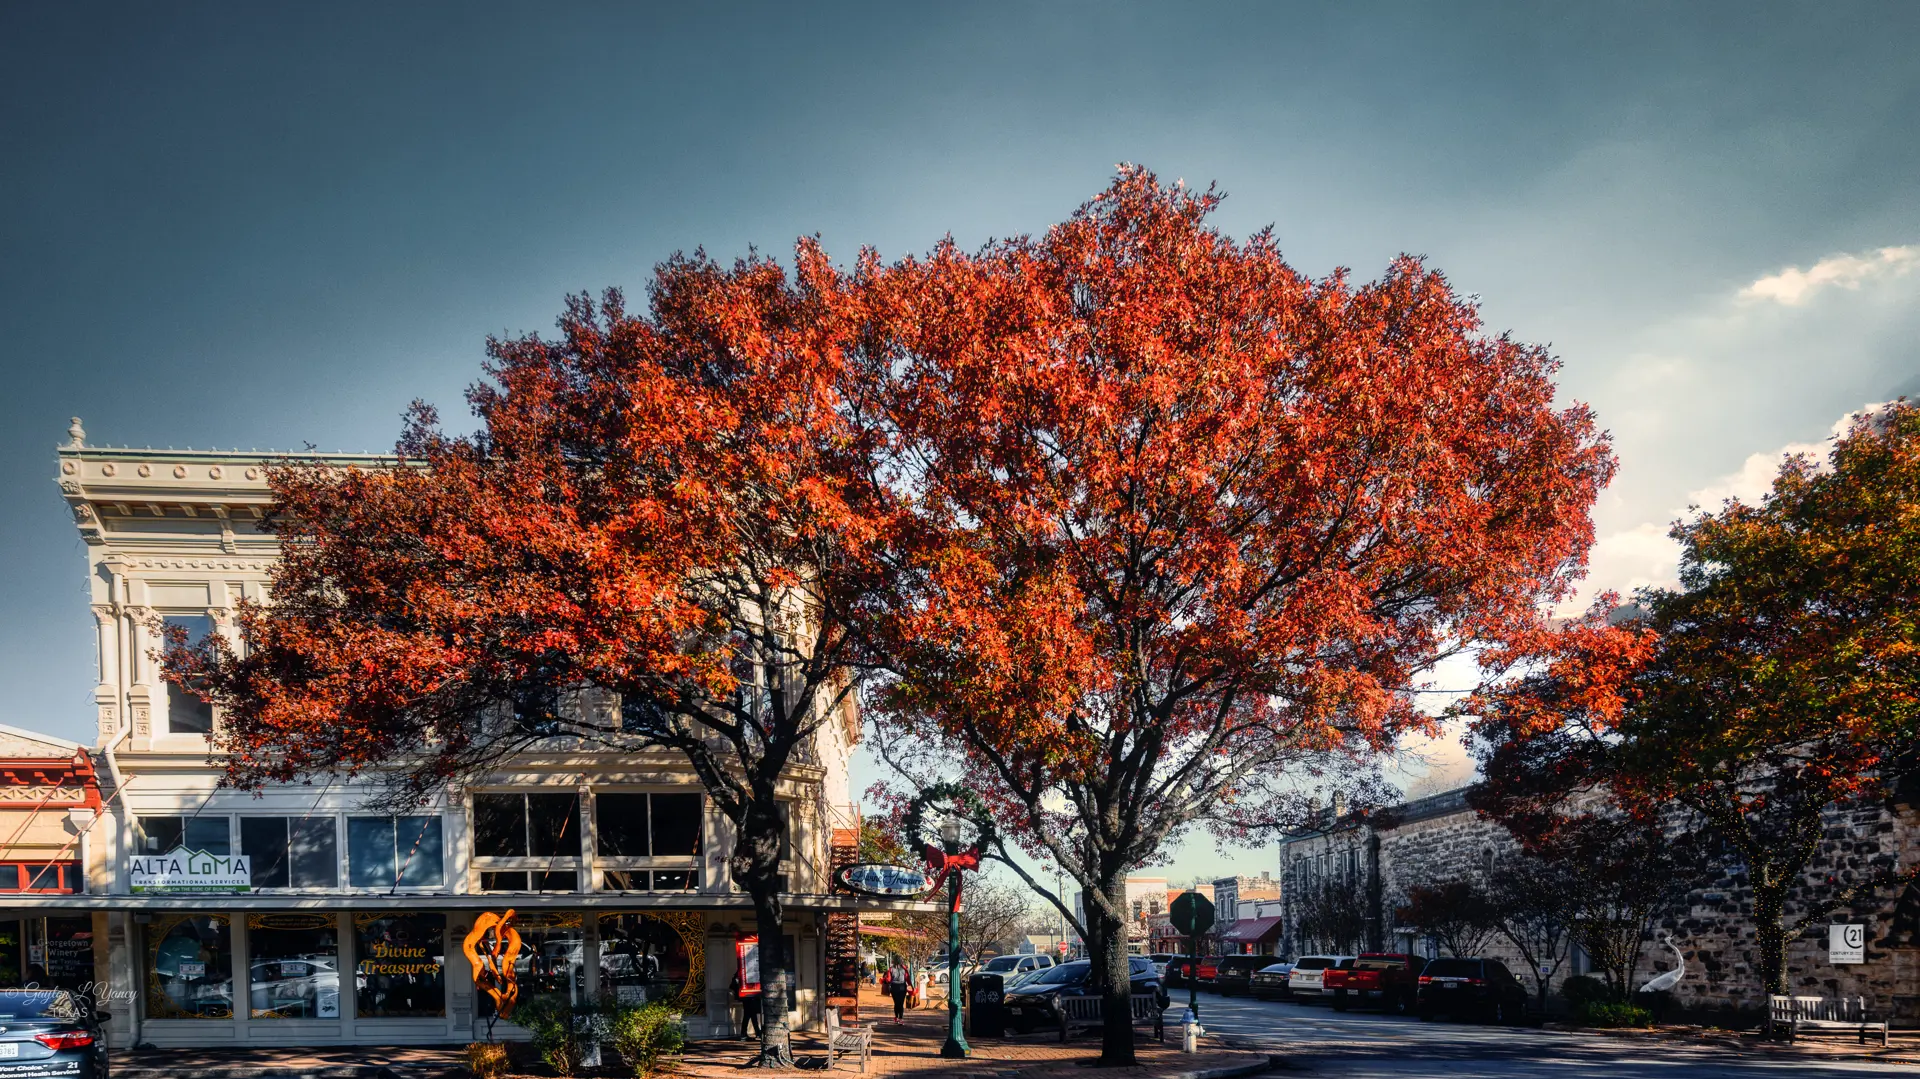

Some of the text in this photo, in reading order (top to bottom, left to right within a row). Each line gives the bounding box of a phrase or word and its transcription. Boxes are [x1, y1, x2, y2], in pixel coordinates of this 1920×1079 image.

[131, 859, 182, 875] ALTA
[48, 948, 79, 957] Winery
[373, 941, 426, 958] Divine
[360, 959, 440, 975] Treasures
